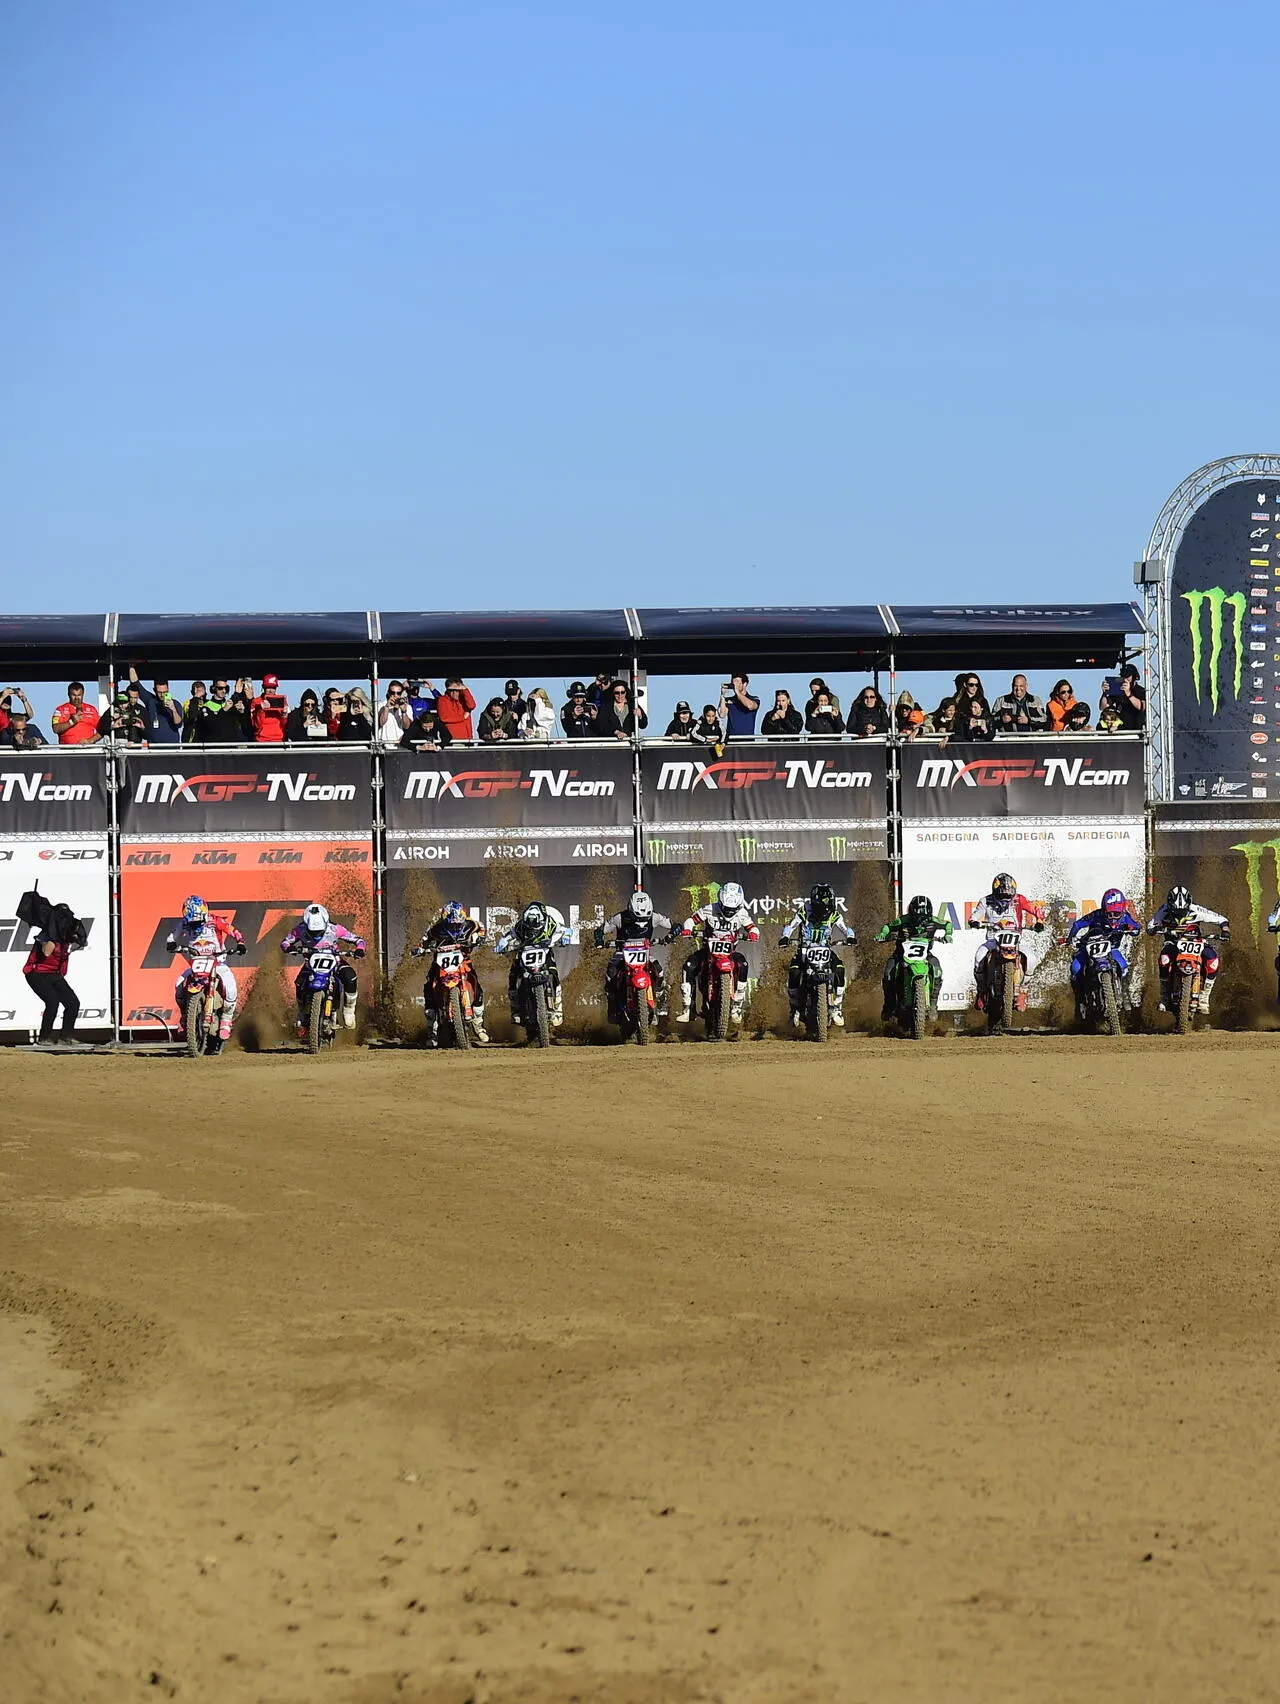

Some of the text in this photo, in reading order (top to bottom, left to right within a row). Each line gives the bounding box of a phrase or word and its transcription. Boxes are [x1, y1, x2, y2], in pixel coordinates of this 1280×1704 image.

[917, 832, 980, 842] SARDEGNA
[992, 832, 1055, 841] SARDEGNA
[1067, 831, 1130, 840] SARDEGNA
[258, 848, 303, 864] KTM
[324, 847, 368, 863] KTM
[393, 846, 450, 860] AIROH
[483, 844, 539, 858] AIROH
[572, 843, 628, 857] AIROH
[125, 850, 171, 866] KTM
[192, 849, 237, 865] KTM
[713, 919, 738, 931] THOR
[997, 934, 1020, 946] 101
[710, 941, 731, 954] 189
[907, 945, 925, 958] 3
[1089, 942, 1108, 955] 87
[1179, 942, 1202, 954] 303
[441, 955, 460, 969] 84
[526, 951, 544, 964] 91
[628, 952, 646, 963] 70
[807, 949, 830, 962] 959
[192, 959, 215, 973] 61
[312, 958, 332, 970] 10
[126, 1006, 173, 1021] KTM
